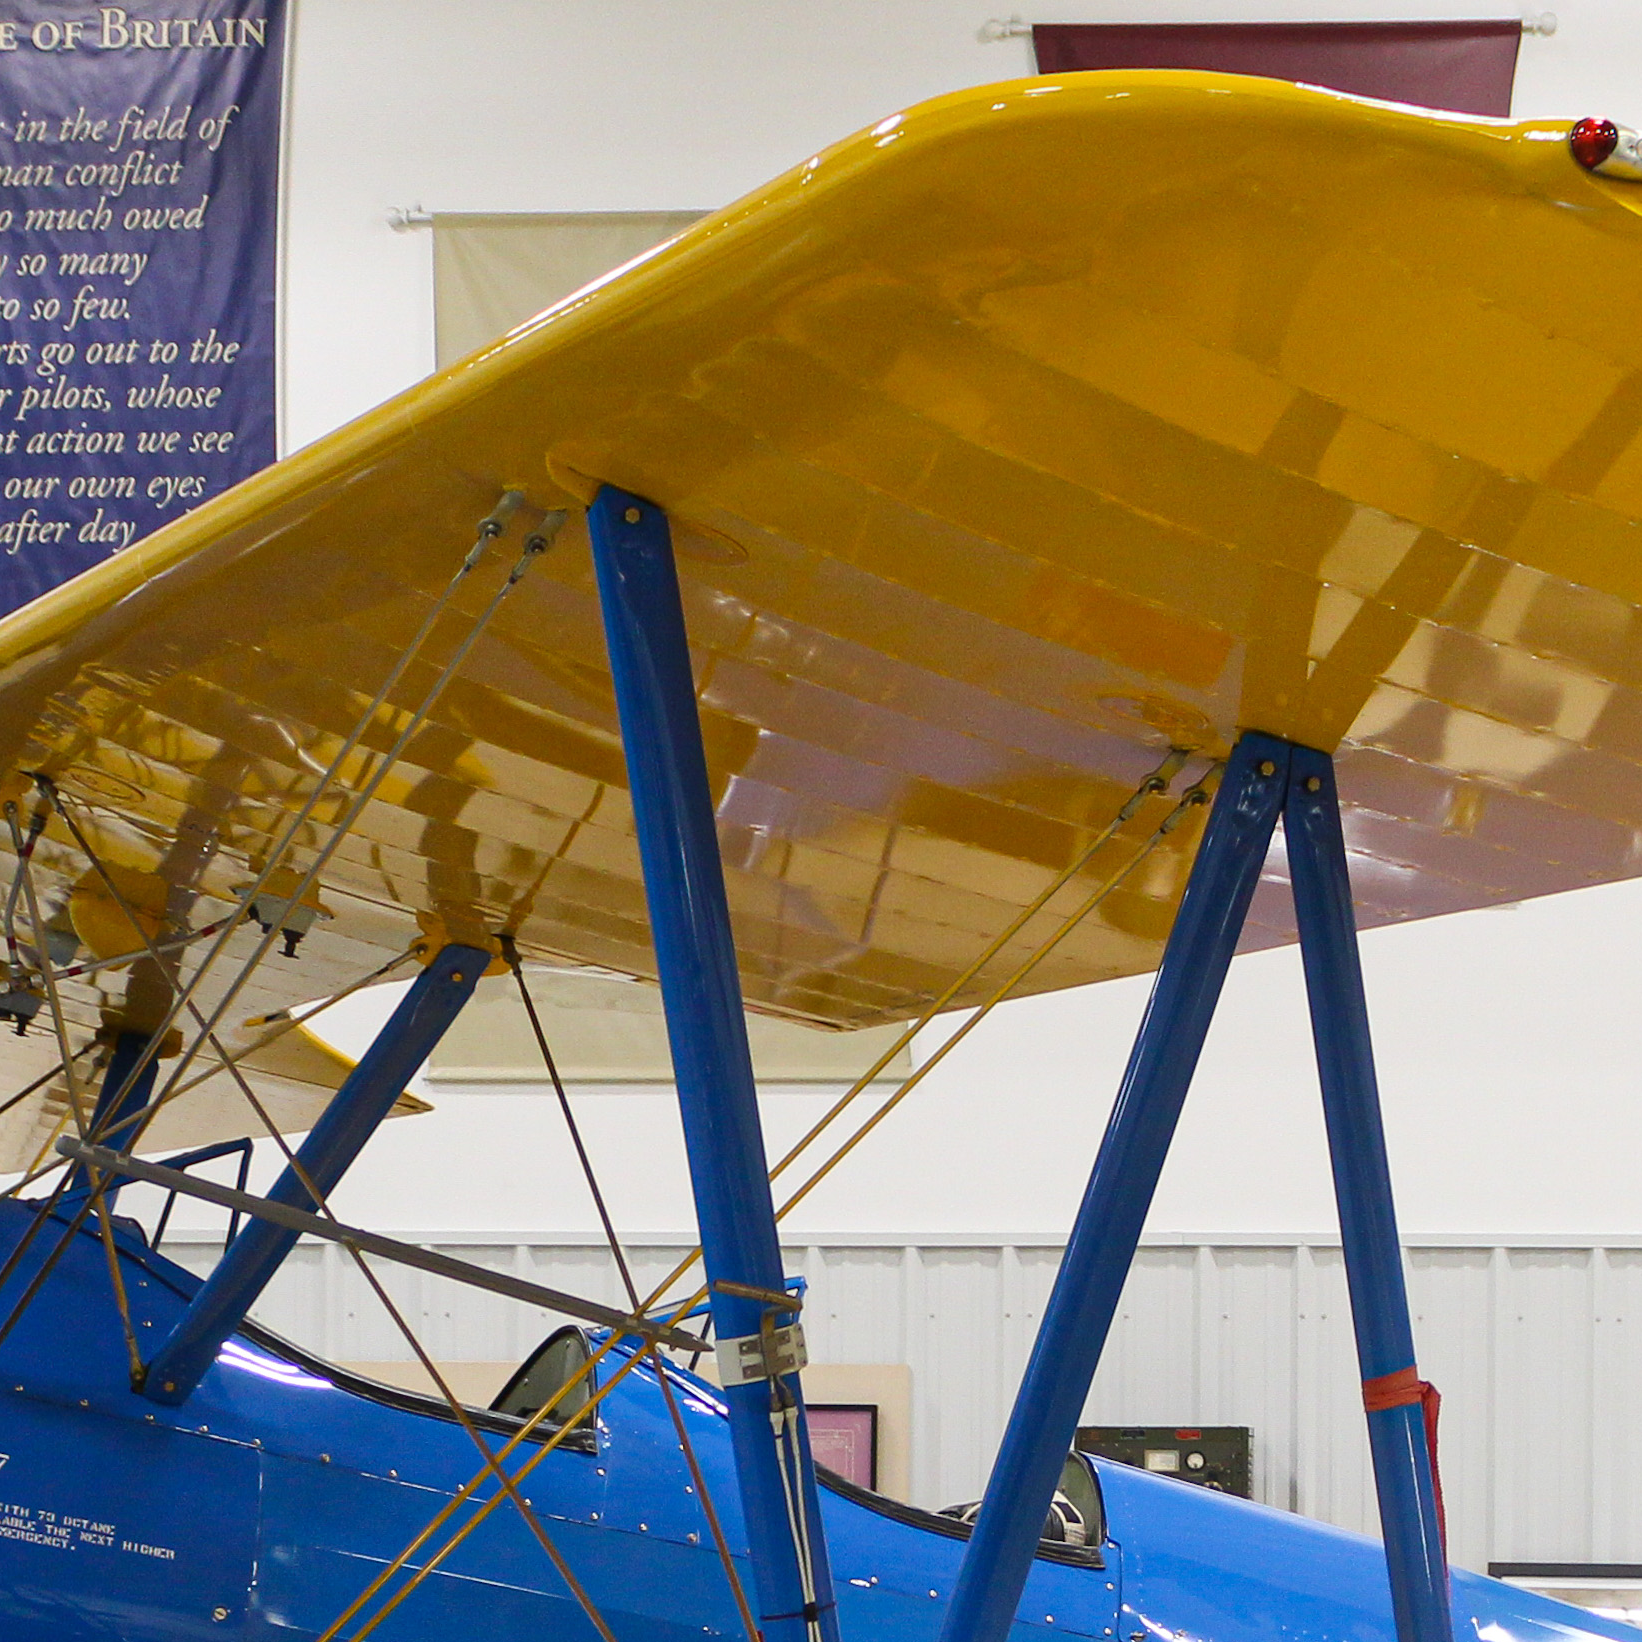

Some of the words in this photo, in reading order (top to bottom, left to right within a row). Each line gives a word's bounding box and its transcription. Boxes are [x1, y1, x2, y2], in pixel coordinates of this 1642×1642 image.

[33, 22, 83, 49] OF
[98, 9, 264, 50] BRITAIN
[15, 111, 46, 141] in
[59, 107, 107, 141] the
[109, 105, 191, 152] field
[199, 101, 239, 151] of
[66, 151, 182, 196] conflict
[25, 196, 112, 230] much
[124, 195, 208, 230] owed
[17, 254, 46, 275] so
[59, 253, 147, 285] many
[30, 299, 60, 320] so
[64, 285, 130, 331] few.
[37, 344, 74, 375] go
[86, 340, 139, 364] out
[149, 340, 178, 363] to
[190, 329, 239, 363] the
[15, 375, 111, 420] pilots,
[128, 374, 221, 408] whose
[26, 422, 124, 453] action
[138, 432, 180, 453] we
[189, 432, 233, 452] see
[5, 478, 60, 498] our
[69, 477, 135, 498] own
[148, 477, 207, 508] eyes
[78, 508, 135, 554] day
[45, 1525, 71, 1538] THE
[123, 1541, 175, 1560] HIGHER
